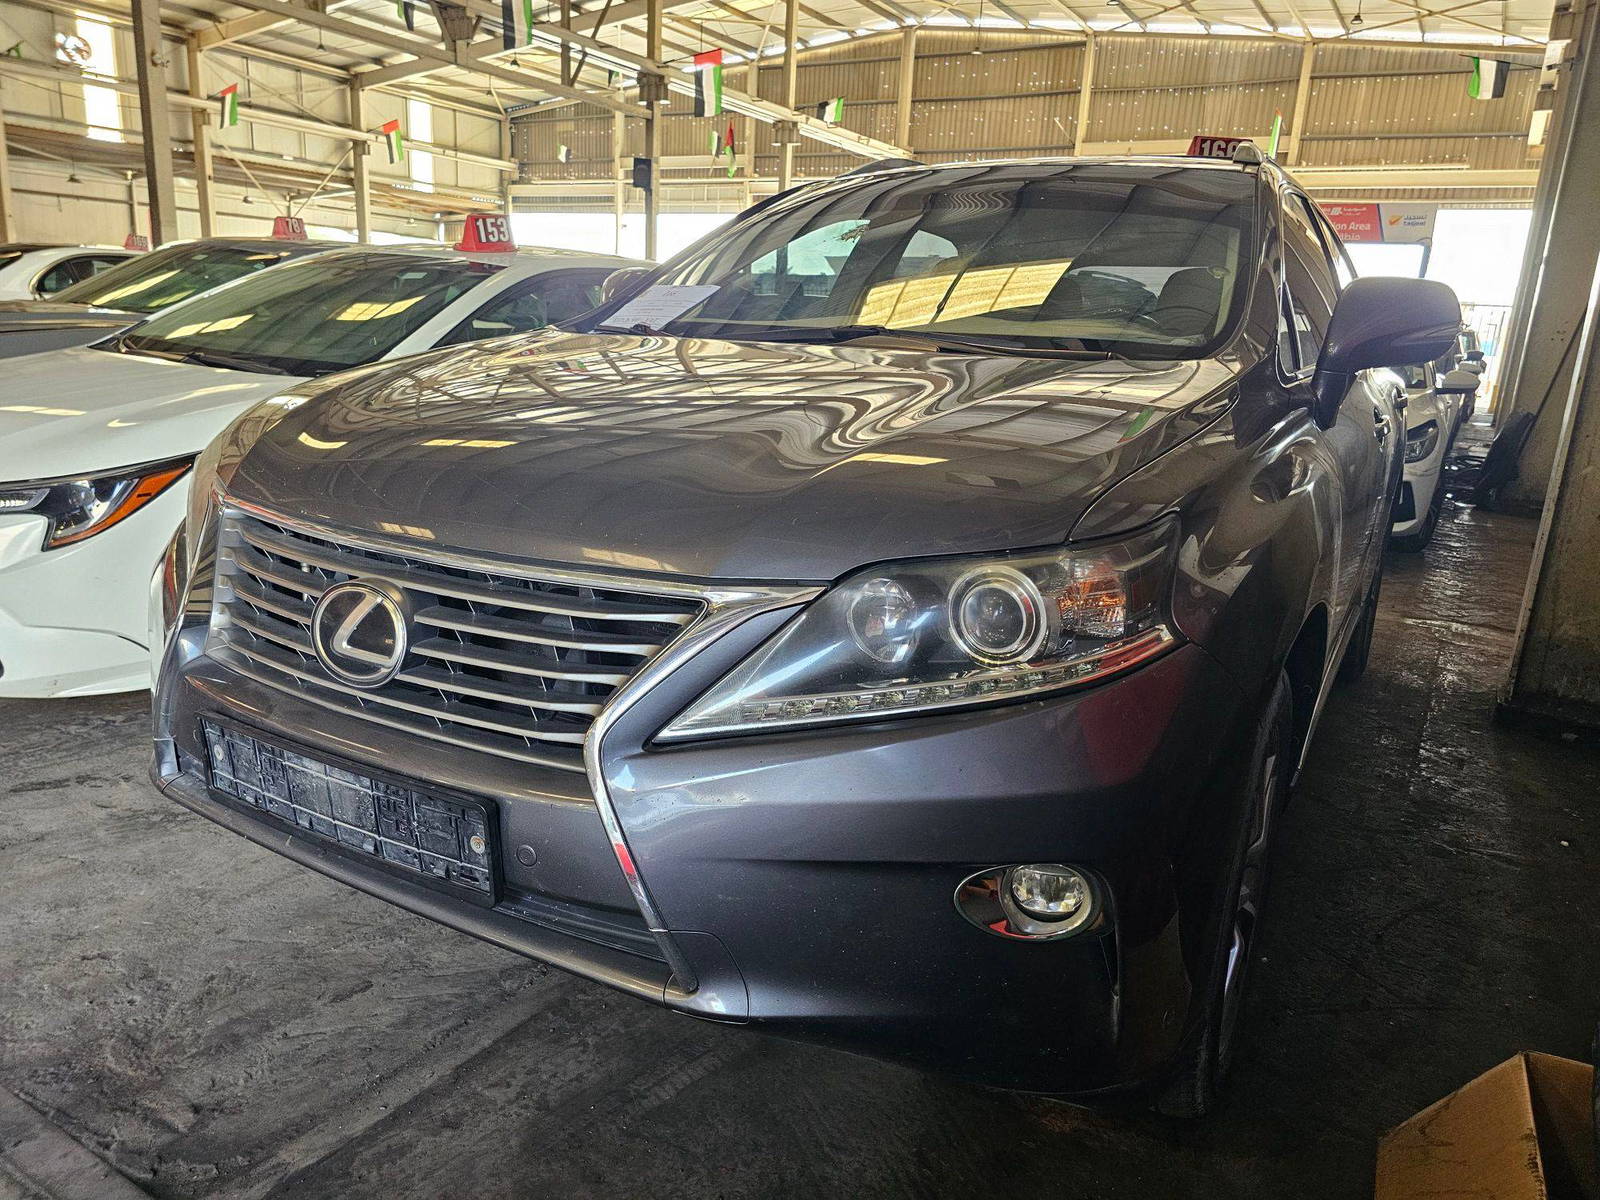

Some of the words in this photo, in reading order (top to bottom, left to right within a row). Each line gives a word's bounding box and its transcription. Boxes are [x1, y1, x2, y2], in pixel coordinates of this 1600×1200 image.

[286, 218, 300, 233] 78
[477, 217, 510, 243] 153
[1349, 222, 1371, 231] Area
